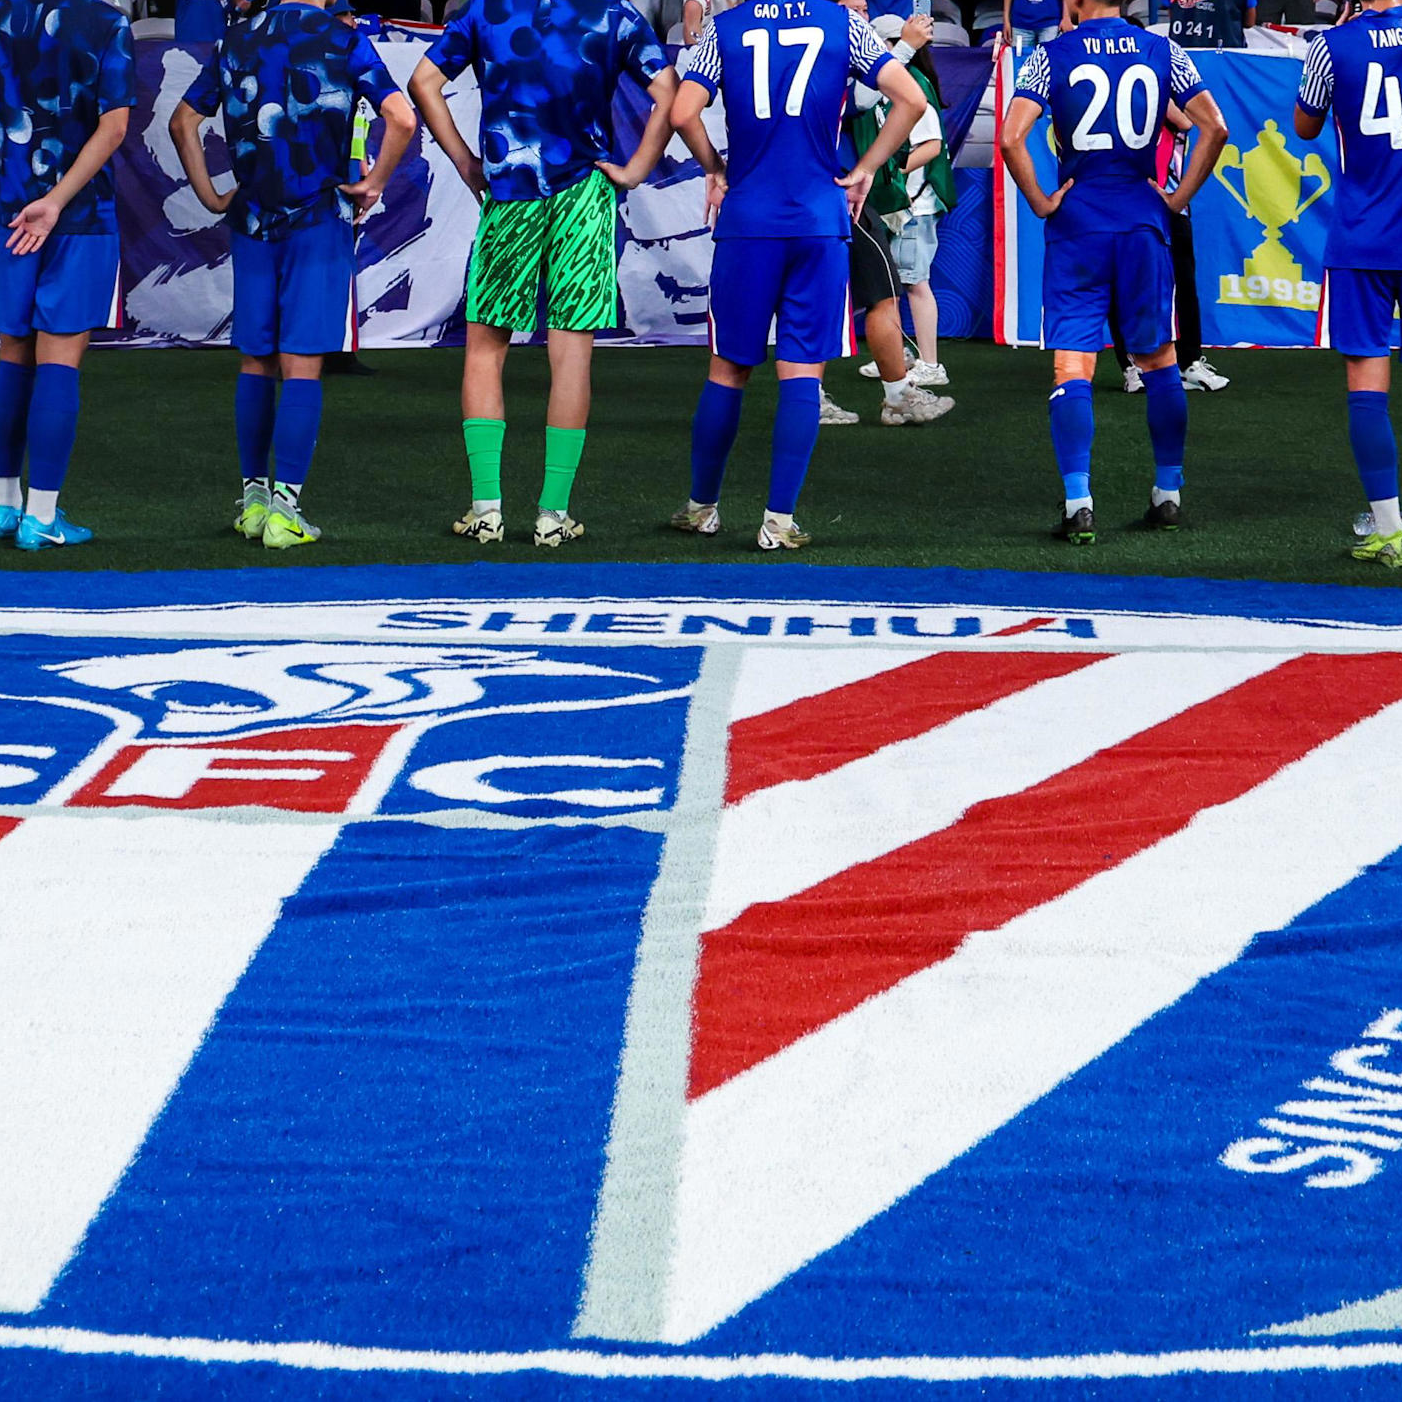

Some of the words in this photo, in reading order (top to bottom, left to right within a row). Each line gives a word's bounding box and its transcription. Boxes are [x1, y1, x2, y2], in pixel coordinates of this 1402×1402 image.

[753, 3, 779, 18] GAO
[783, 1, 811, 19] T.Y.
[1083, 37, 1101, 54] YU
[1105, 36, 1141, 54] H.CH.
[741, 26, 824, 120] 17
[1068, 63, 1159, 151] 20
[1225, 272, 1320, 306] 1998
[377, 609, 1100, 638] SHENHUA
